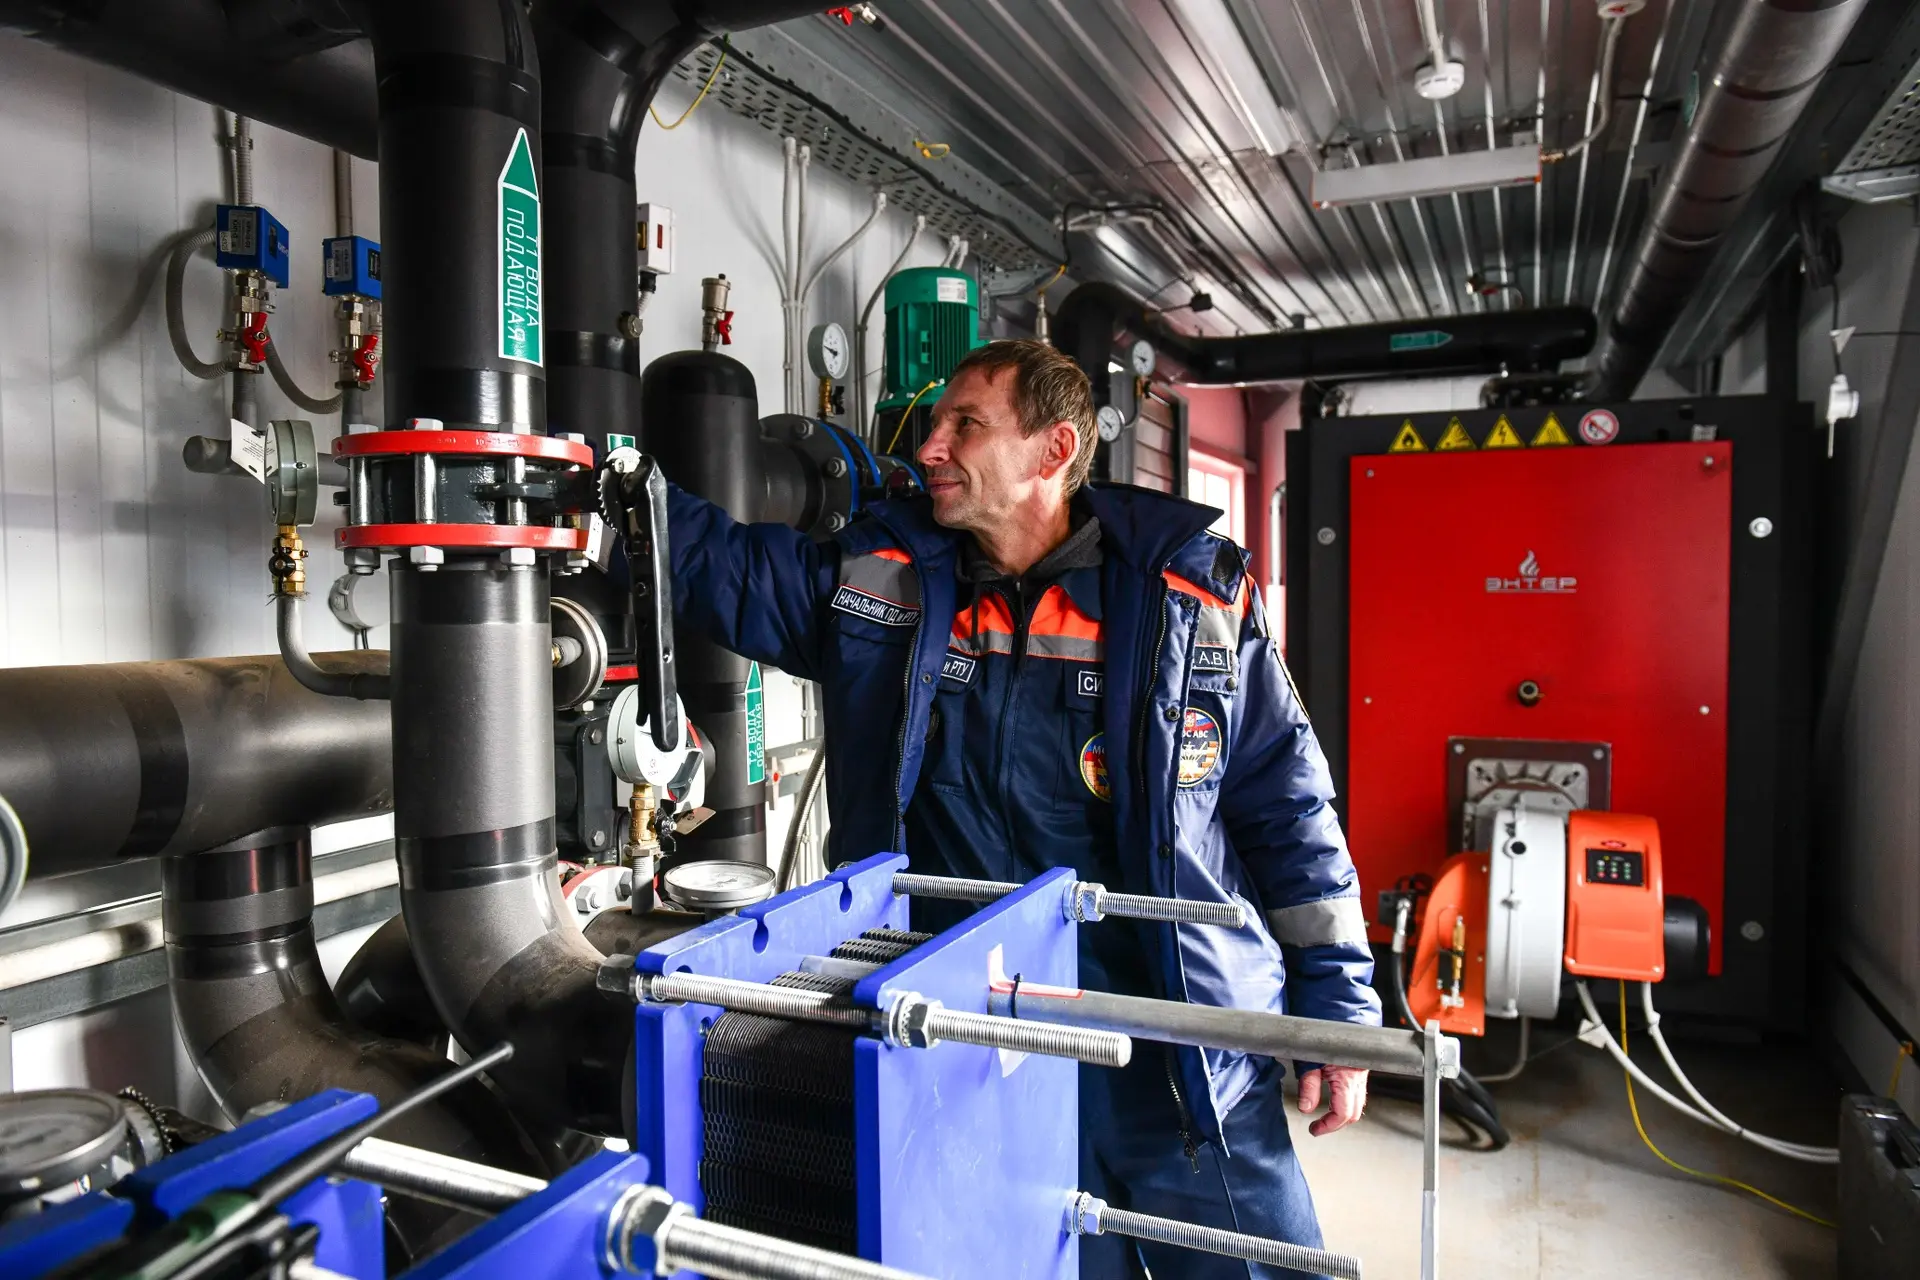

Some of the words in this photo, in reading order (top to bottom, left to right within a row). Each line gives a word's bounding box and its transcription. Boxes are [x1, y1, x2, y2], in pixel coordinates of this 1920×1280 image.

[505, 207, 526, 342] ПОДАЮЩАЯ
[525, 265, 539, 327] ВОДА
[1486, 577, 1577, 590] ЭНТЕР
[837, 591, 888, 619] НАЧАЛЬНИК
[885, 607, 900, 624] ПД
[1199, 651, 1225, 666] А.В.
[950, 660, 970, 676] РТУ
[748, 708, 757, 744] ВОДА
[1193, 730, 1209, 739] АВС
[748, 749, 757, 766] Т2
